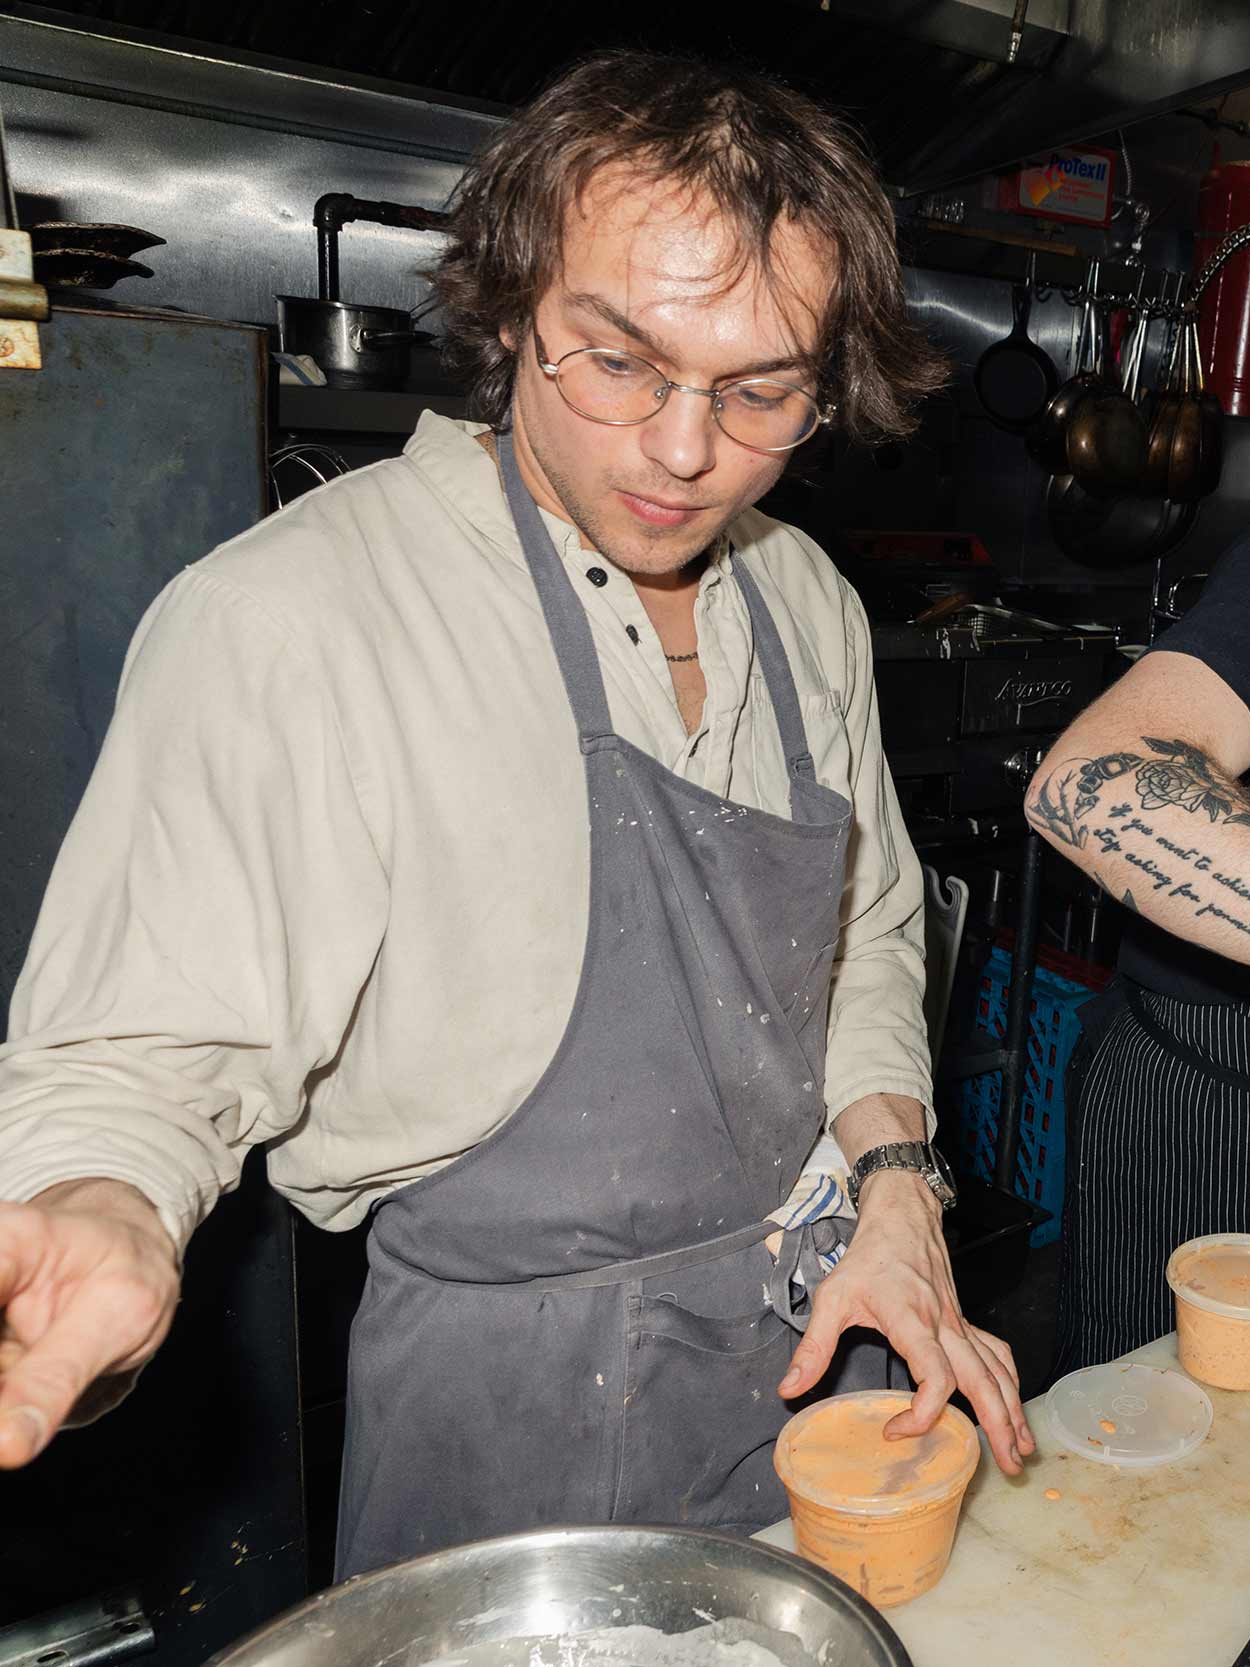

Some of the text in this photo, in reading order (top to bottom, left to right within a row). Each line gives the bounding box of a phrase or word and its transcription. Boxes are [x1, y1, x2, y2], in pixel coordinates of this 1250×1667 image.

[1093, 828, 1122, 853] stop
[1125, 853, 1172, 890] asking
[1168, 883, 1201, 902] for
[1108, 802, 1133, 818] If
[1121, 818, 1153, 835] you
[1156, 837, 1199, 860] want
[1194, 856, 1212, 871] to
